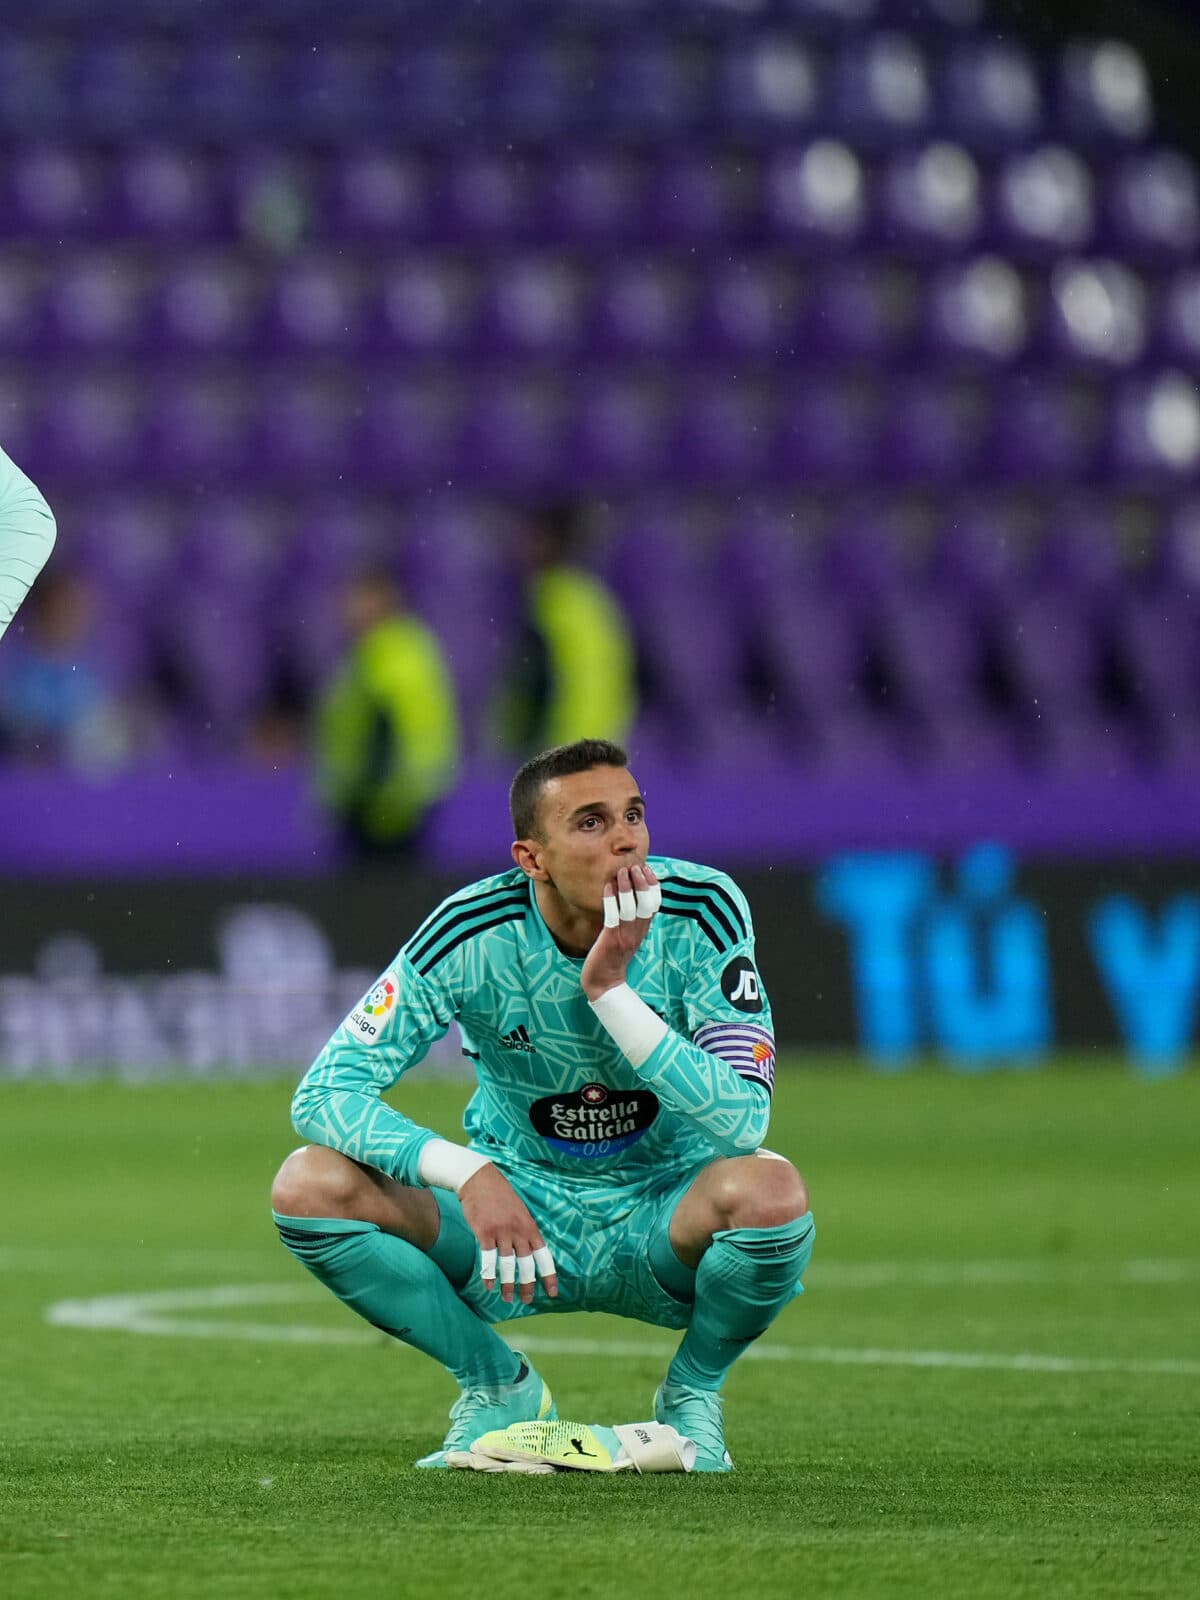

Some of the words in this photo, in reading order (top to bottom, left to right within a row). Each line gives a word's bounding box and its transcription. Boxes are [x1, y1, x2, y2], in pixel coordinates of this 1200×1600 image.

[730, 969, 759, 1001] JD
[498, 1039, 537, 1054] adidas
[550, 1101, 639, 1122] Estrella
[554, 1119, 637, 1140] Galicia
